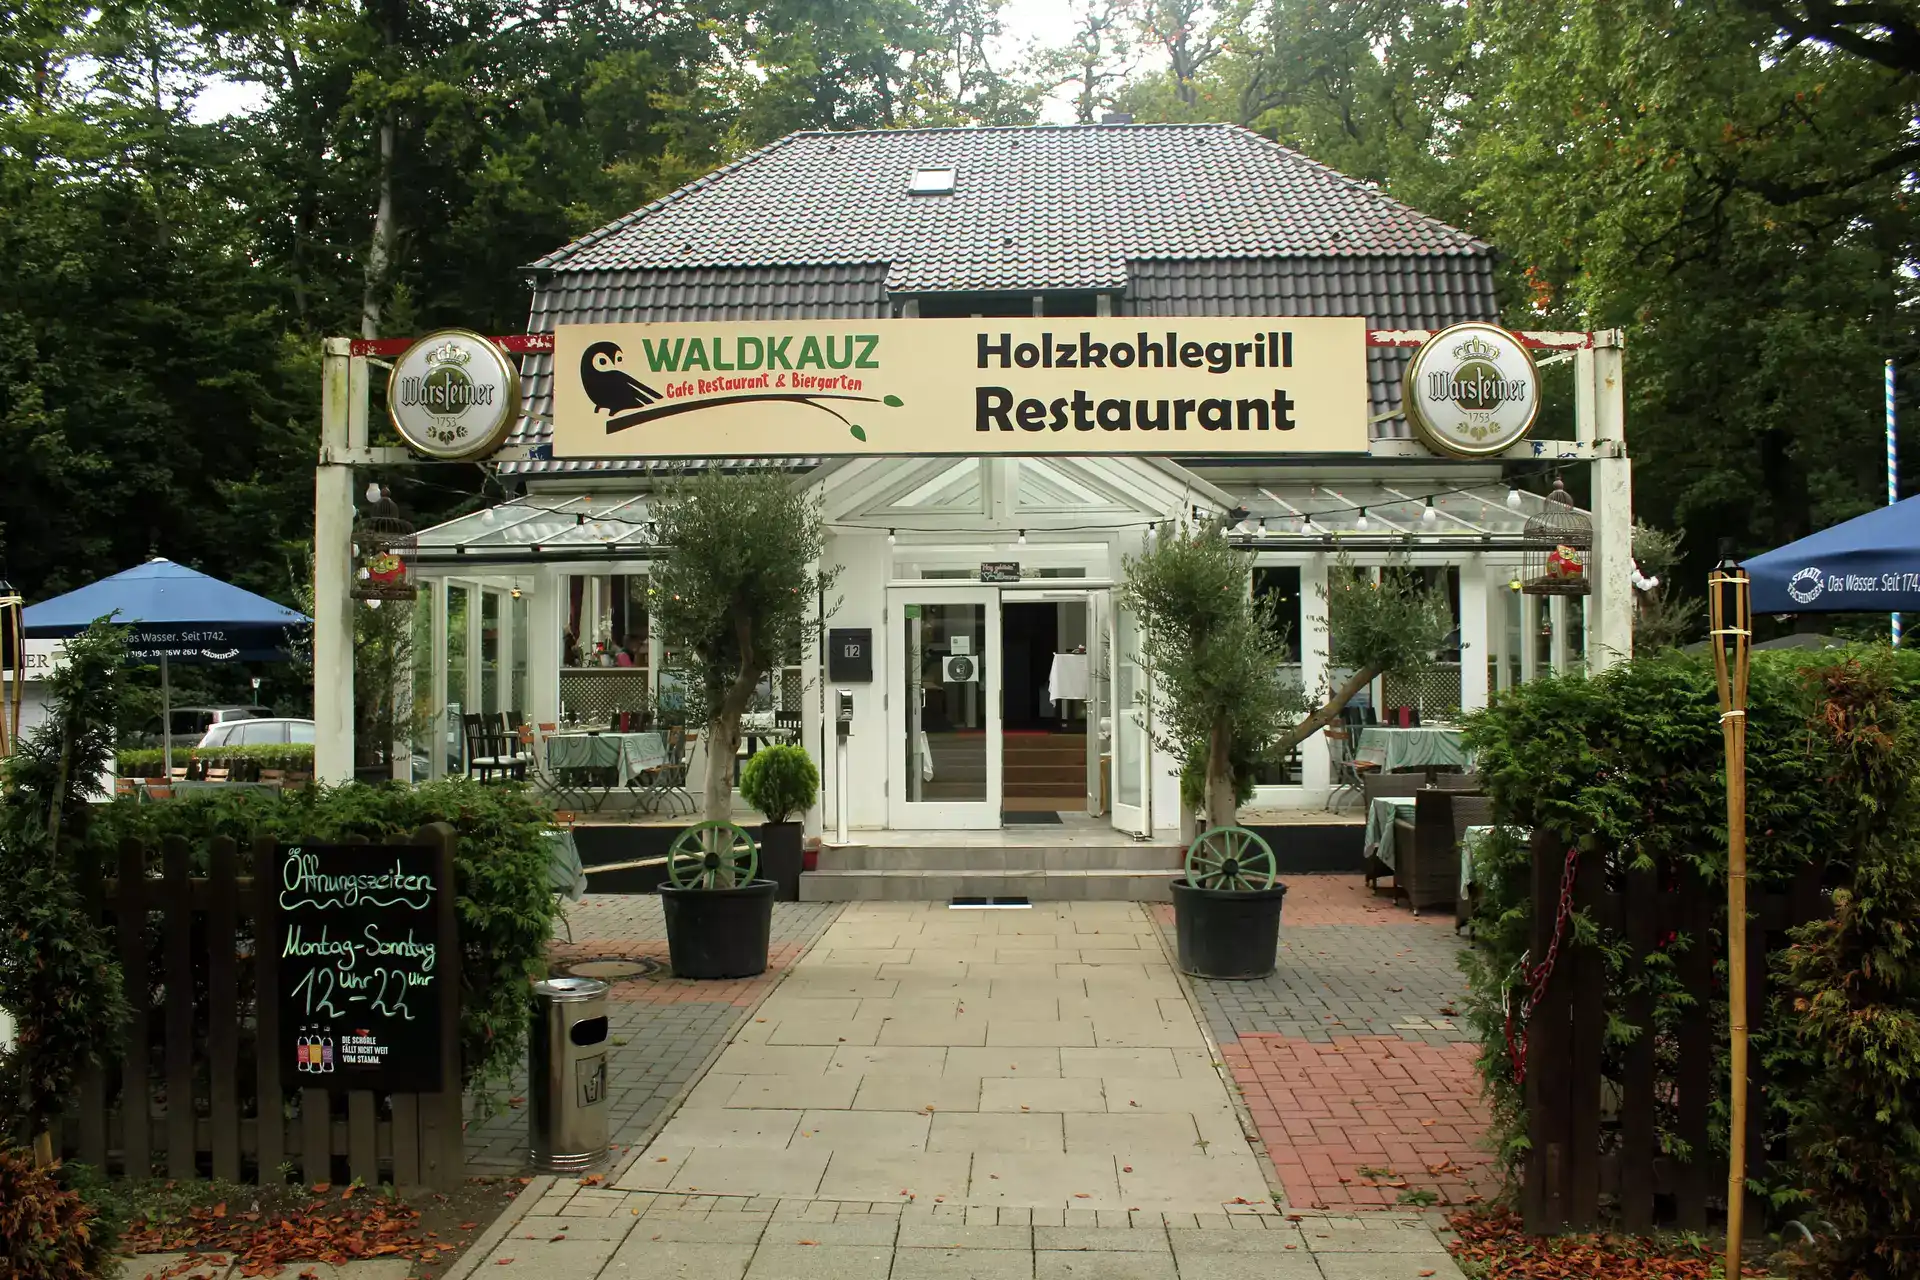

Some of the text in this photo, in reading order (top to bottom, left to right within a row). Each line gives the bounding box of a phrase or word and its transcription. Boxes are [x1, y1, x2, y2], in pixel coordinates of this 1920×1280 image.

[642, 334, 879, 373] WALDKAUZ
[976, 332, 1293, 374] Holzkohlegrill
[401, 372, 495, 413] Warsteiner
[666, 372, 862, 399] Cafe Restaurant & Biergarten
[1428, 366, 1526, 407] Warsteiner
[975, 386, 1296, 432] Restaurant
[1468, 412, 1490, 424] 1753
[436, 417, 457, 428] 1753
[1827, 575, 1844, 592] Das
[1845, 574, 1879, 592] Wasser.
[1881, 572, 1900, 591] Seit
[141, 632, 179, 642] Wasser.
[182, 630, 200, 642] Seit
[202, 631, 227, 641] 1742.
[846, 645, 859, 657] 12
[283, 848, 437, 906] Öffnungszeiten
[291, 966, 346, 1018] 12
[339, 971, 375, 989] Uhr
[371, 967, 415, 1020] 22
[408, 972, 434, 987] Uhr
[342, 1036, 351, 1044] DIE
[342, 1044, 357, 1054] FÄLLT
[357, 1046, 373, 1054] NICHT
[373, 1046, 388, 1055] WEIT
[342, 1055, 381, 1064] VOM STAMM.
